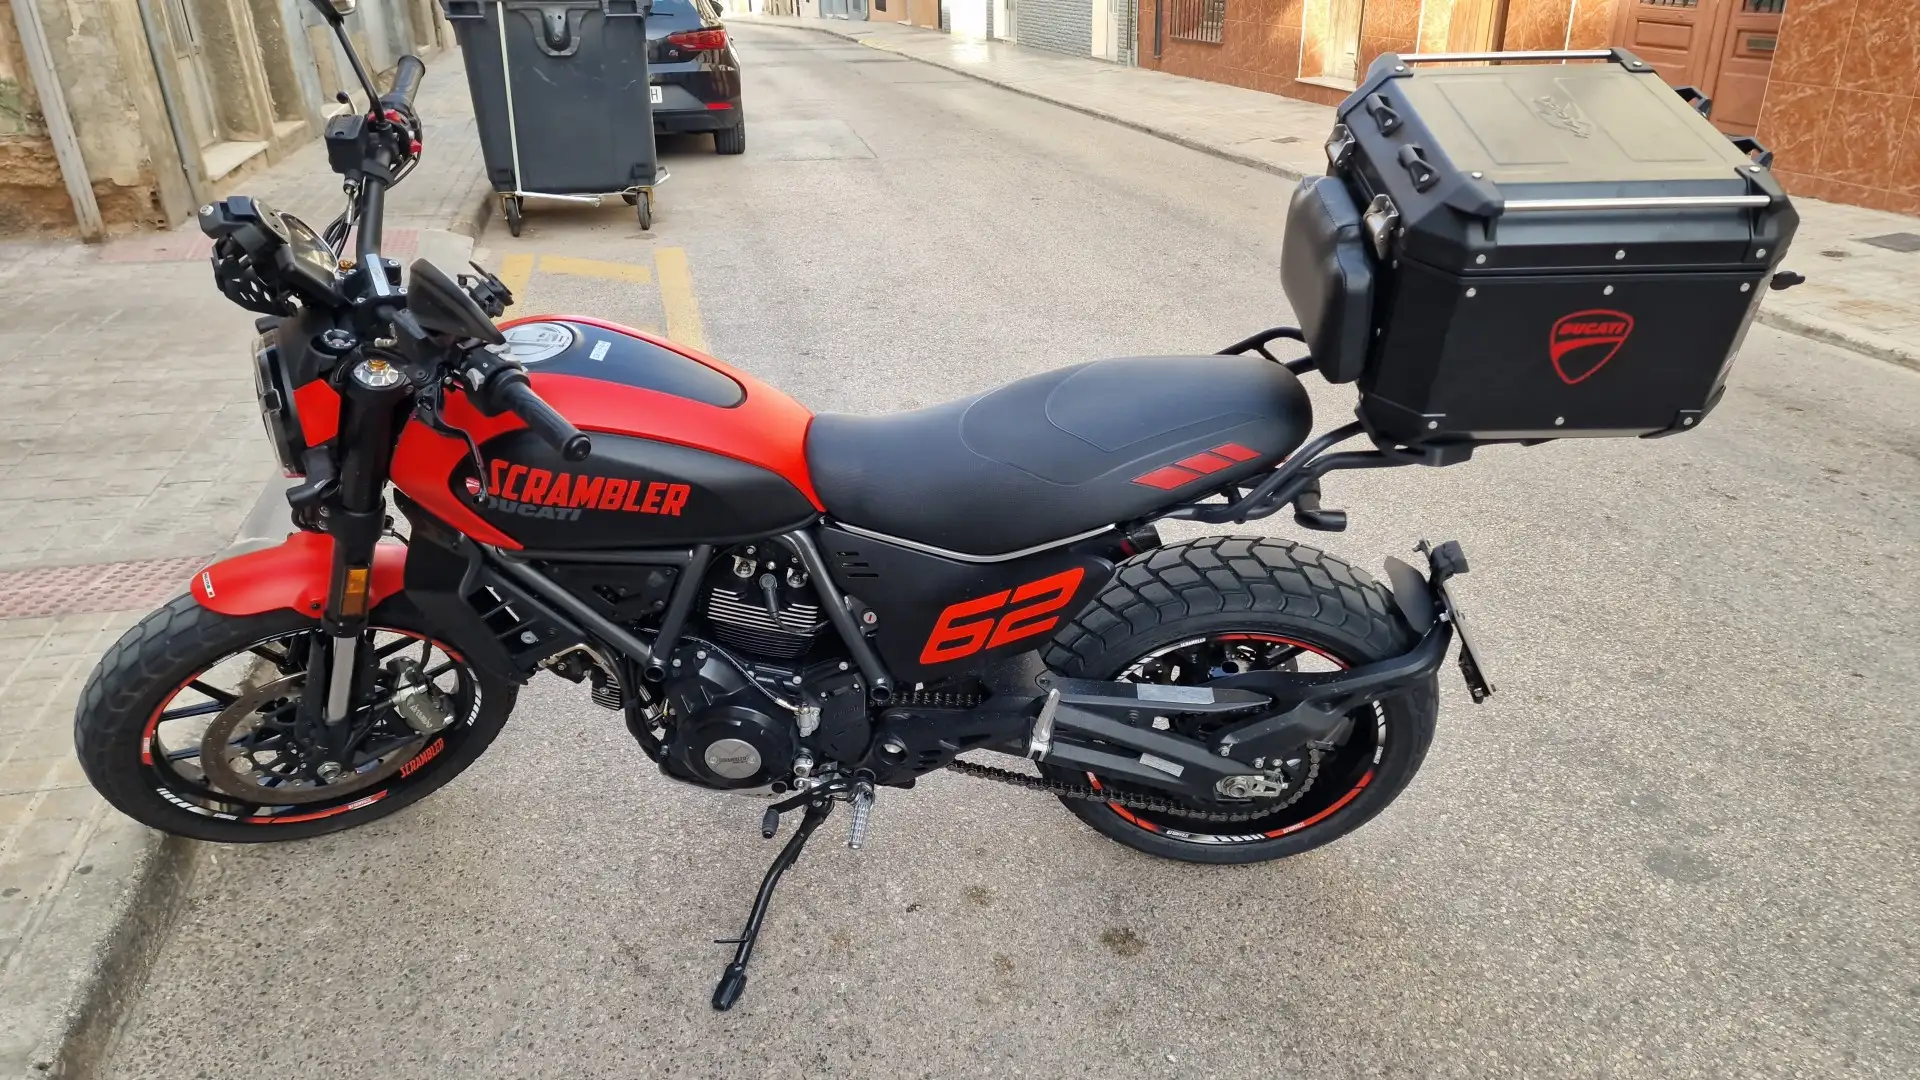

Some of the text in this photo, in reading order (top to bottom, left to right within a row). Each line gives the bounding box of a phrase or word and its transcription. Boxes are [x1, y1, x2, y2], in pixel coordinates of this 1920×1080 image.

[1558, 321, 1626, 335] DUCATI
[487, 495, 581, 521] DUCATI
[488, 459, 691, 517] SCRAMBLER
[919, 566, 1085, 665] 62
[400, 737, 444, 779] SCRAMBLER
